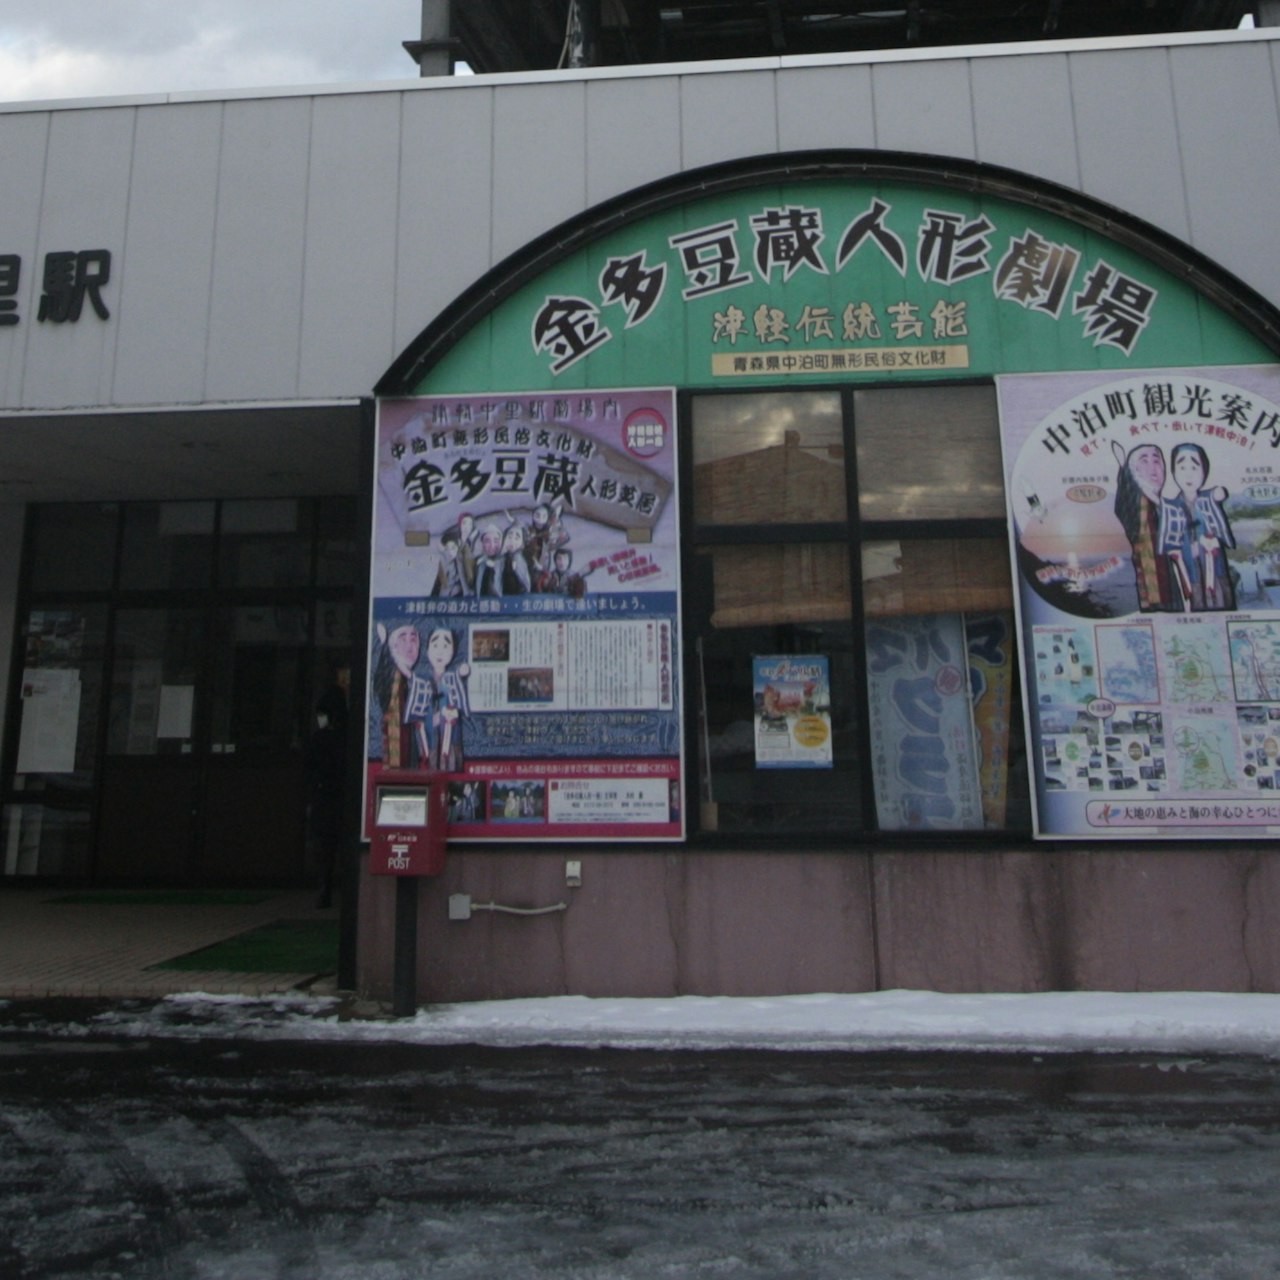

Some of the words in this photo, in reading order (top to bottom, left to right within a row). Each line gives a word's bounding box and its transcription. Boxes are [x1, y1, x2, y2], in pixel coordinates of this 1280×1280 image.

[531, 196, 1159, 376] 金多豆蔵人形劇場
[710, 299, 971, 345] 津軽伝統芸能
[732, 349, 948, 373] 青森県中泊町無形民俗文化財
[390, 426, 596, 461] 中泊町無形民俗文化財
[387, 857, 411, 870] POST
